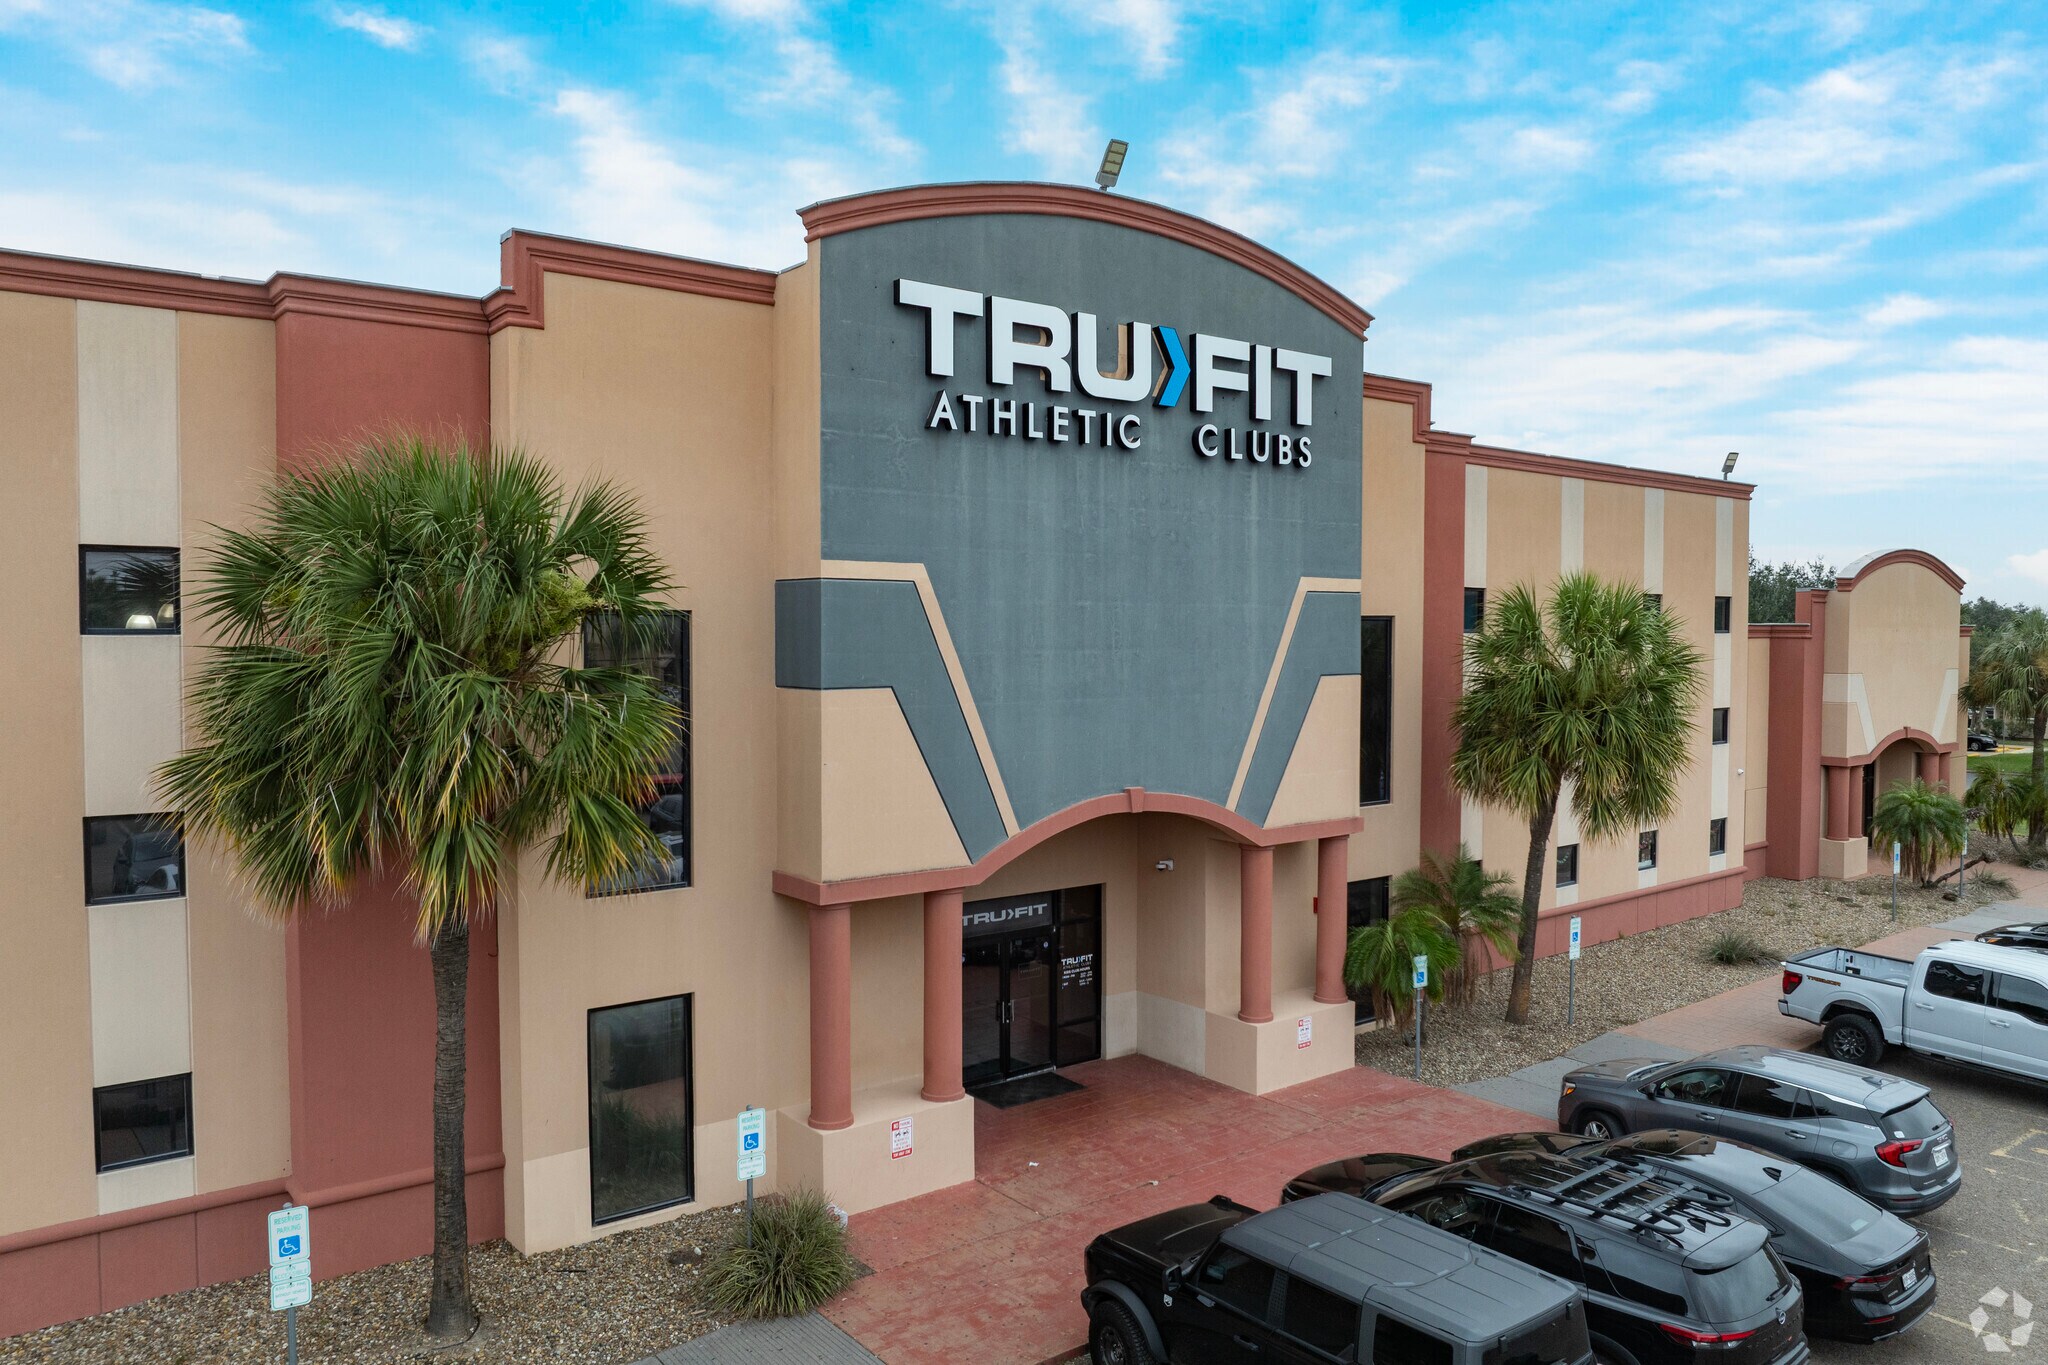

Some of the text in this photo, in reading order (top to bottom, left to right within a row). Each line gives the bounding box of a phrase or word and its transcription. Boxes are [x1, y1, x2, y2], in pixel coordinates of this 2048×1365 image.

[924, 389, 1312, 468] ATHLETIC CLUBS
[274, 1213, 302, 1225] RESERVED
[276, 1224, 301, 1234] PARKING
